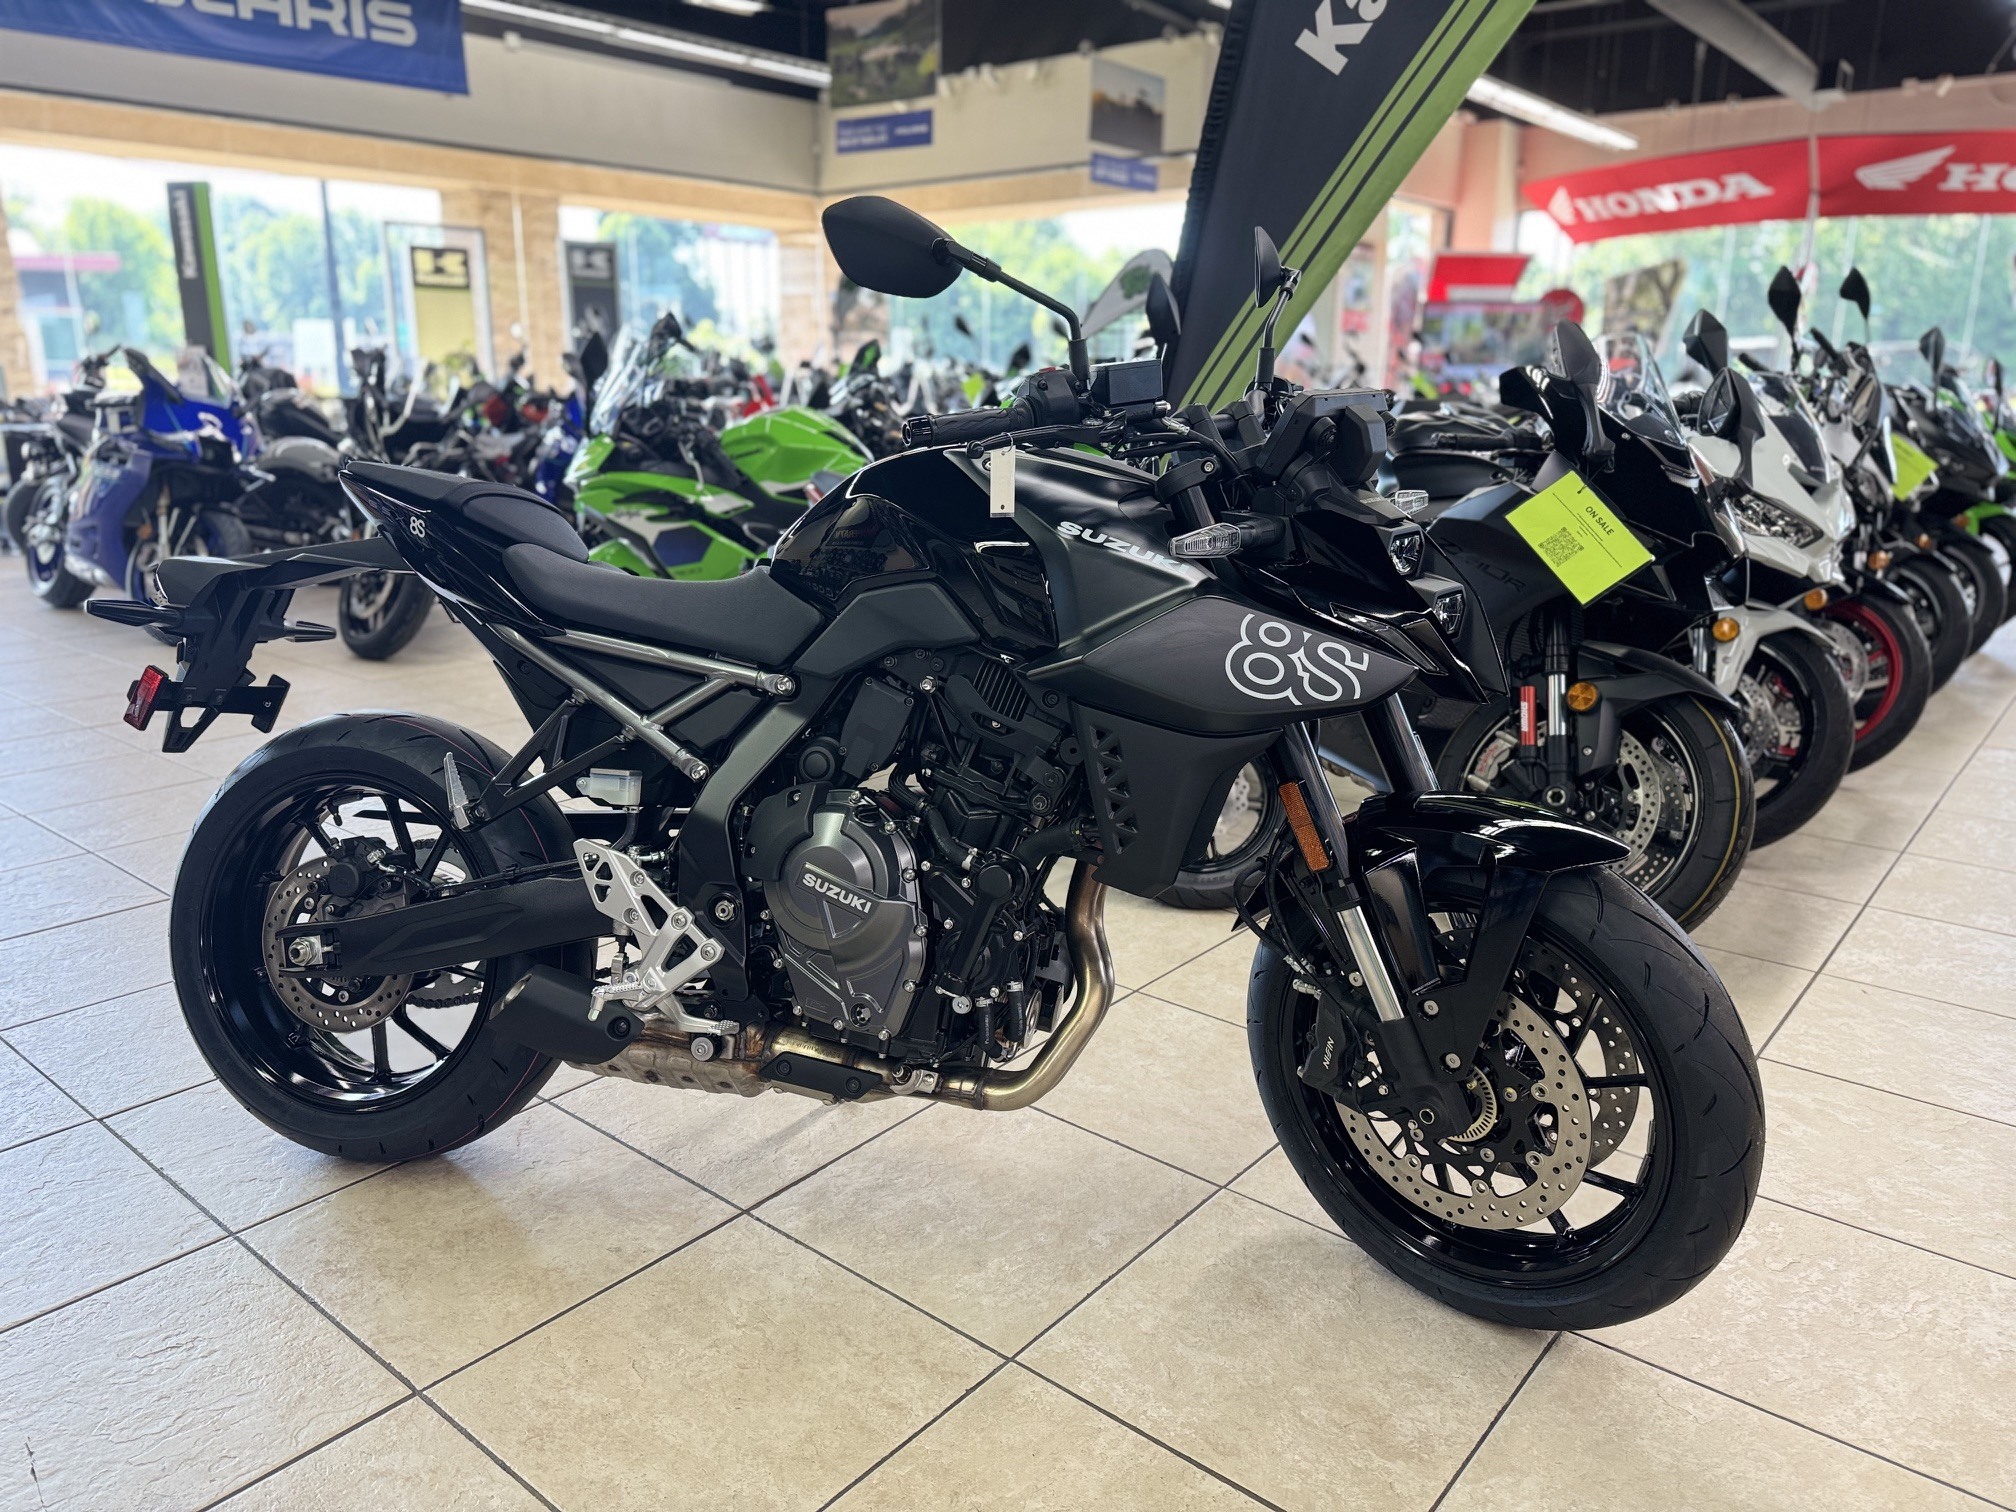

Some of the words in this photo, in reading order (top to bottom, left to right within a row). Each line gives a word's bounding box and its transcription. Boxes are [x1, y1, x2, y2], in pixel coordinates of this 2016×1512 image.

[1574, 172, 1775, 222] HONDA
[1585, 505, 1597, 519] ON
[1595, 518, 1615, 536] SALE
[1057, 521, 1190, 574] SUZUKI
[802, 873, 872, 914] SUZUKI
[1322, 1036, 1335, 1070] NISSIN
